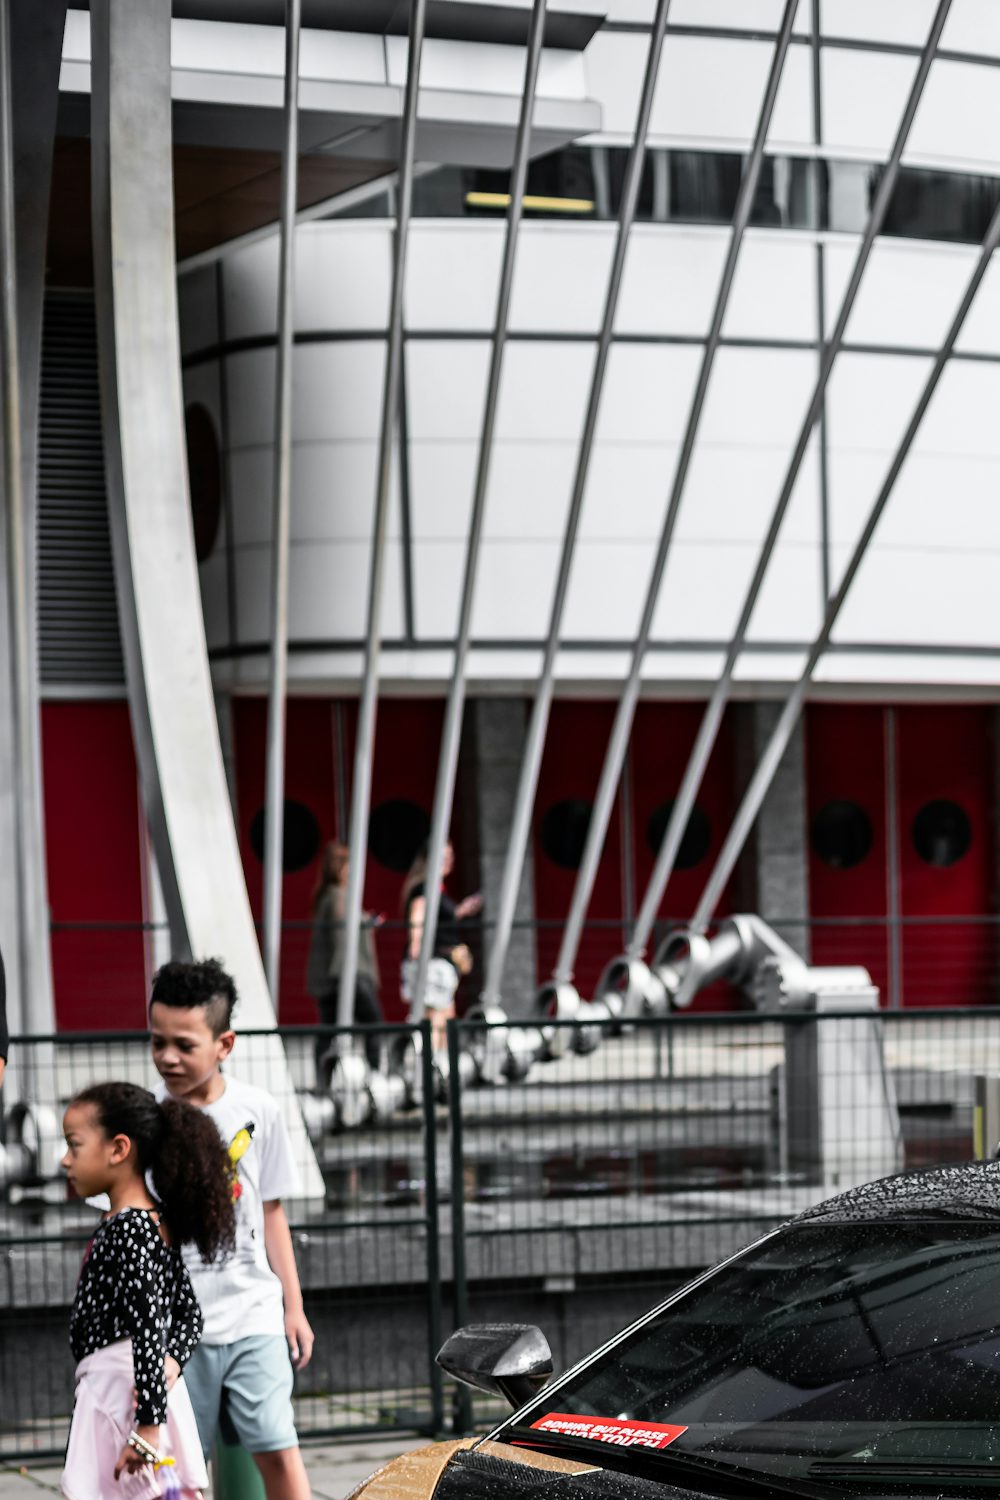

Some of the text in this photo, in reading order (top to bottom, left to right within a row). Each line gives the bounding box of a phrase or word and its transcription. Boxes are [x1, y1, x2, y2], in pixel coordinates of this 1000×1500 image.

[540, 1420, 594, 1431] ADMIRE
[591, 1424, 622, 1433] BUT
[618, 1428, 669, 1440] PLEASE
